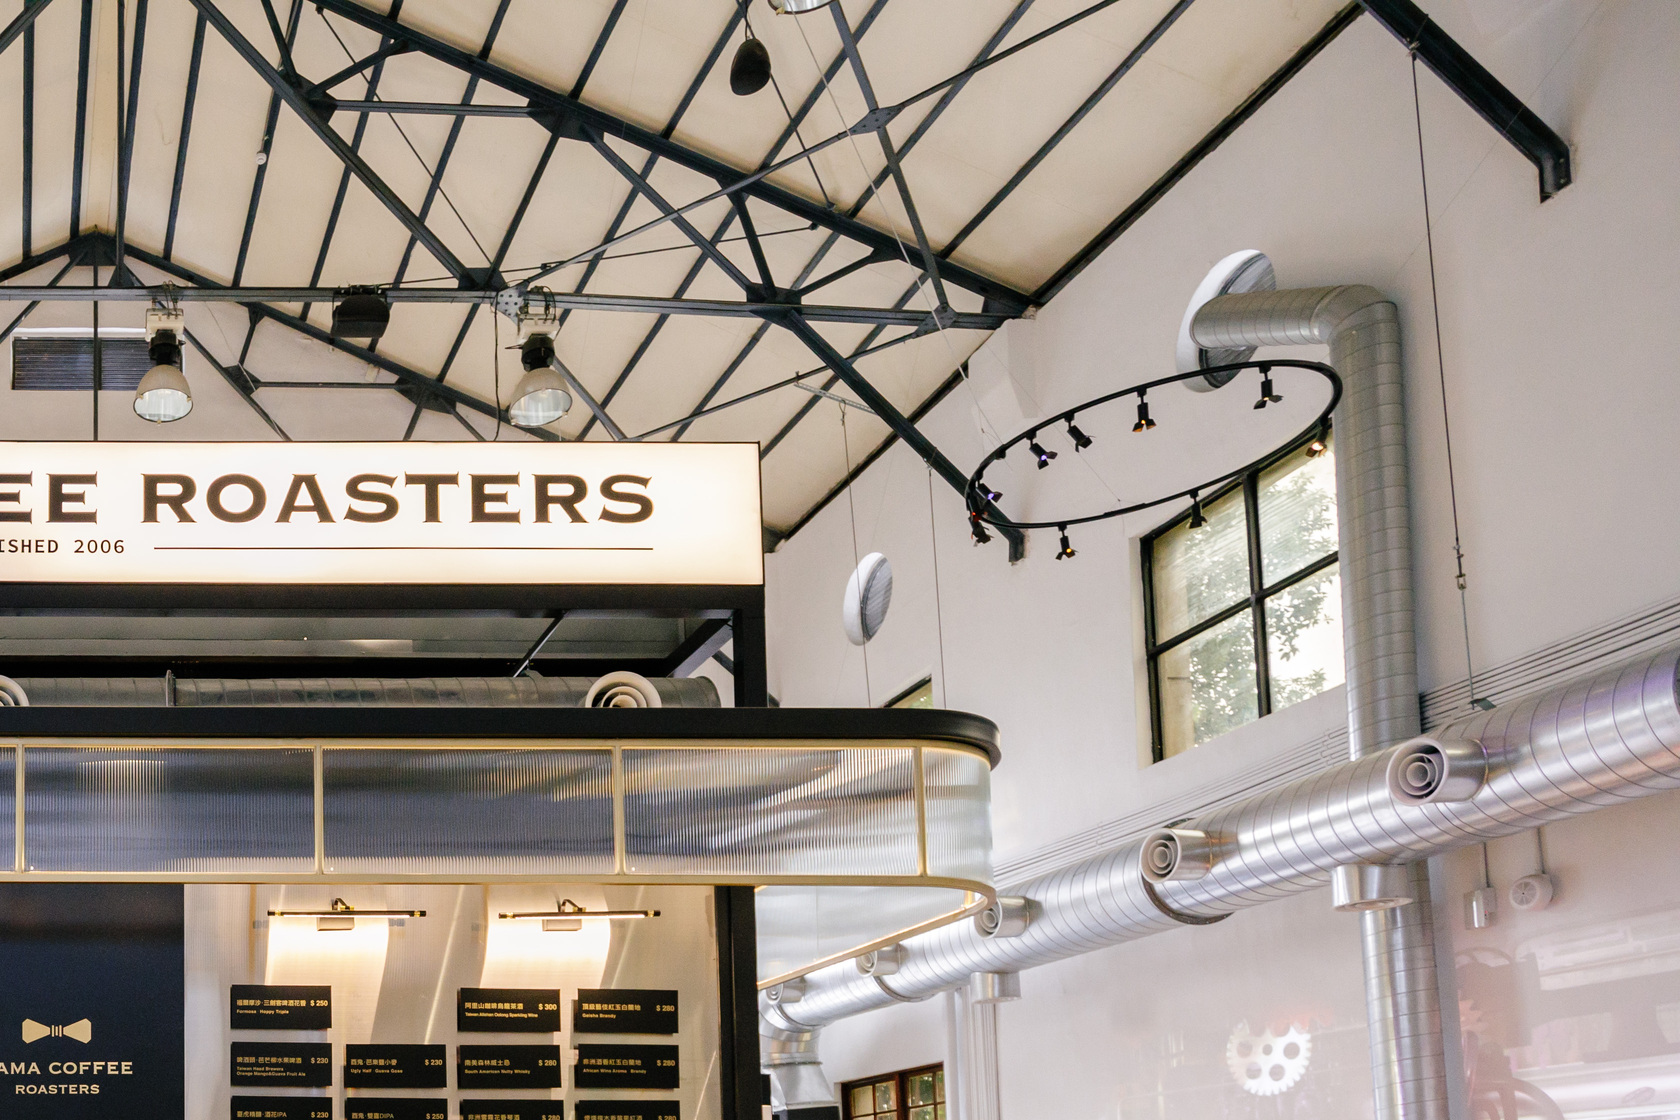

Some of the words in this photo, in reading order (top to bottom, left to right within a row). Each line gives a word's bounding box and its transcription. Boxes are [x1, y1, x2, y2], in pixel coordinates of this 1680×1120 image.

[141, 473, 654, 523] ROASTERS
[74, 539, 124, 554] 2006
[48, 1061, 134, 1075] COFFEE
[15, 1084, 100, 1095] ROASTERS
